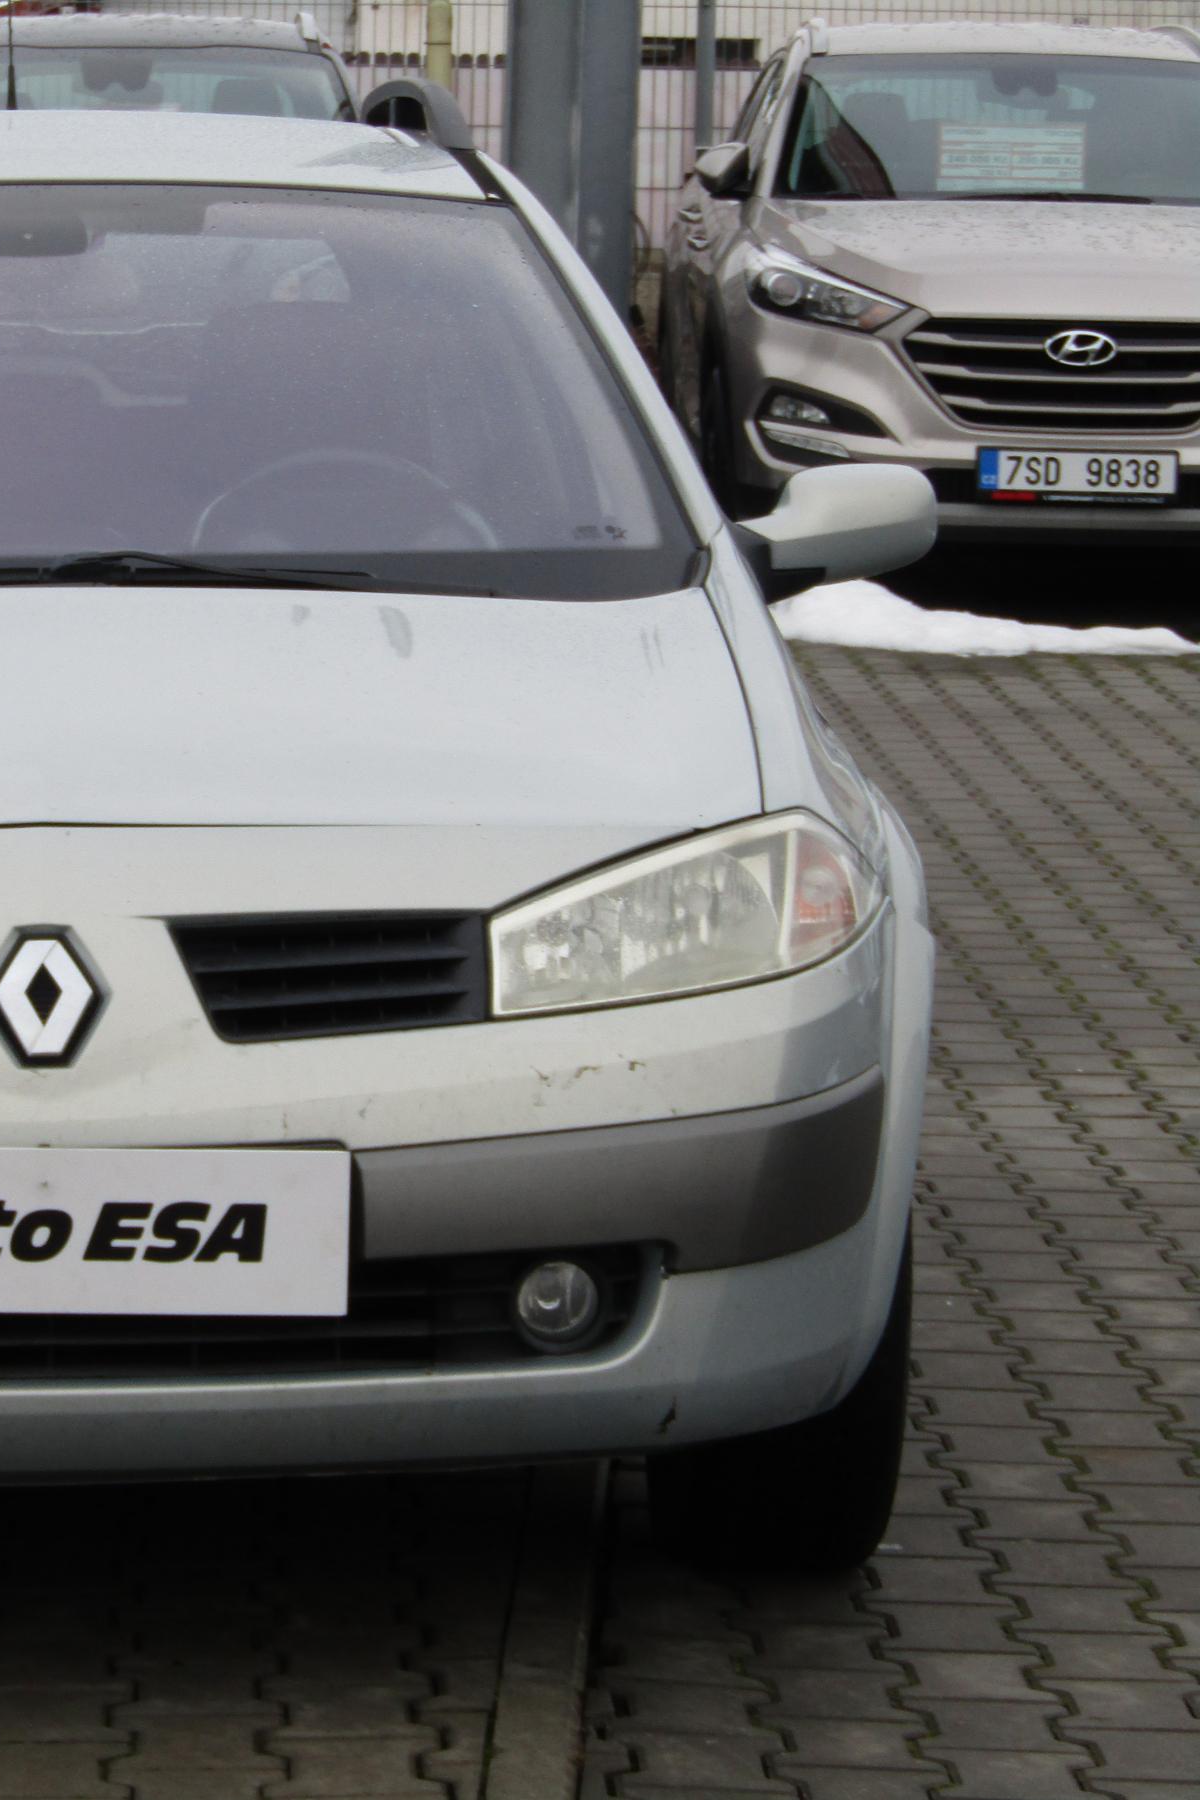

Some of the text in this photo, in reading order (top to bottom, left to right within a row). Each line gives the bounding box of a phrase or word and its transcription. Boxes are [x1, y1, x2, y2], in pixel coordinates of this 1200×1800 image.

[1006, 455, 1160, 489] 7SD 9838
[82, 1202, 267, 1263] ESA
